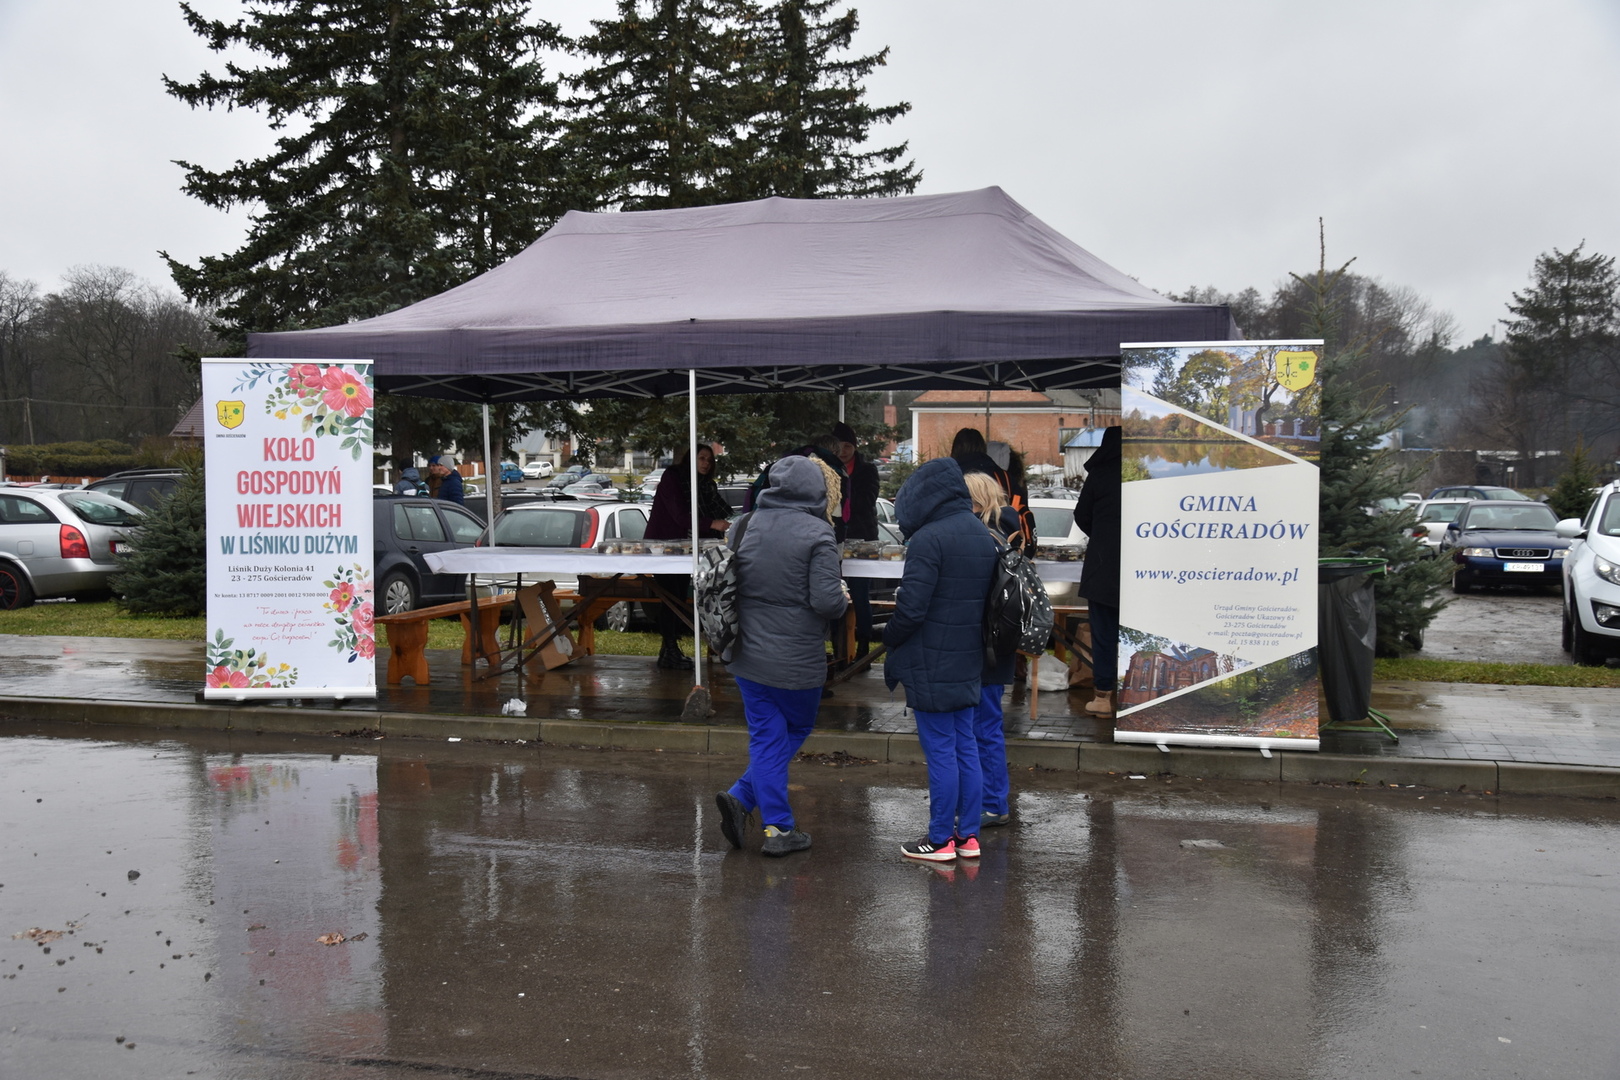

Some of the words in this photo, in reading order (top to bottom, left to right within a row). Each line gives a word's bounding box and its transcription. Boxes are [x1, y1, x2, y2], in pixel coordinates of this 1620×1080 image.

[263, 436, 315, 462] KOŁO
[236, 465, 342, 495] GOSPODYŃ
[1179, 495, 1258, 512] GMINA
[236, 503, 342, 528] WIEJSKICH
[1135, 518, 1310, 540] GOŚCIERADÓW
[220, 535, 236, 555] W
[240, 532, 300, 555] LIŚNIKU
[304, 532, 358, 555] DUŻYM
[228, 565, 252, 573] Liśnik
[253, 565, 273, 574] Duży
[274, 565, 304, 573] Kolonia
[231, 574, 241, 582] 23
[247, 574, 262, 582] 275
[263, 574, 313, 582] Gościeradów
[1135, 567, 1299, 586] www.goscieradow.pl
[1213, 604, 1233, 613] Urząd
[1234, 604, 1256, 613] Gminy
[1215, 612, 1255, 620] Gościeradów
[1256, 613, 1286, 622] Ukazowy
[1246, 621, 1287, 629] Gościeradów
[1231, 631, 1303, 640] poczta@goscieradow.pl
